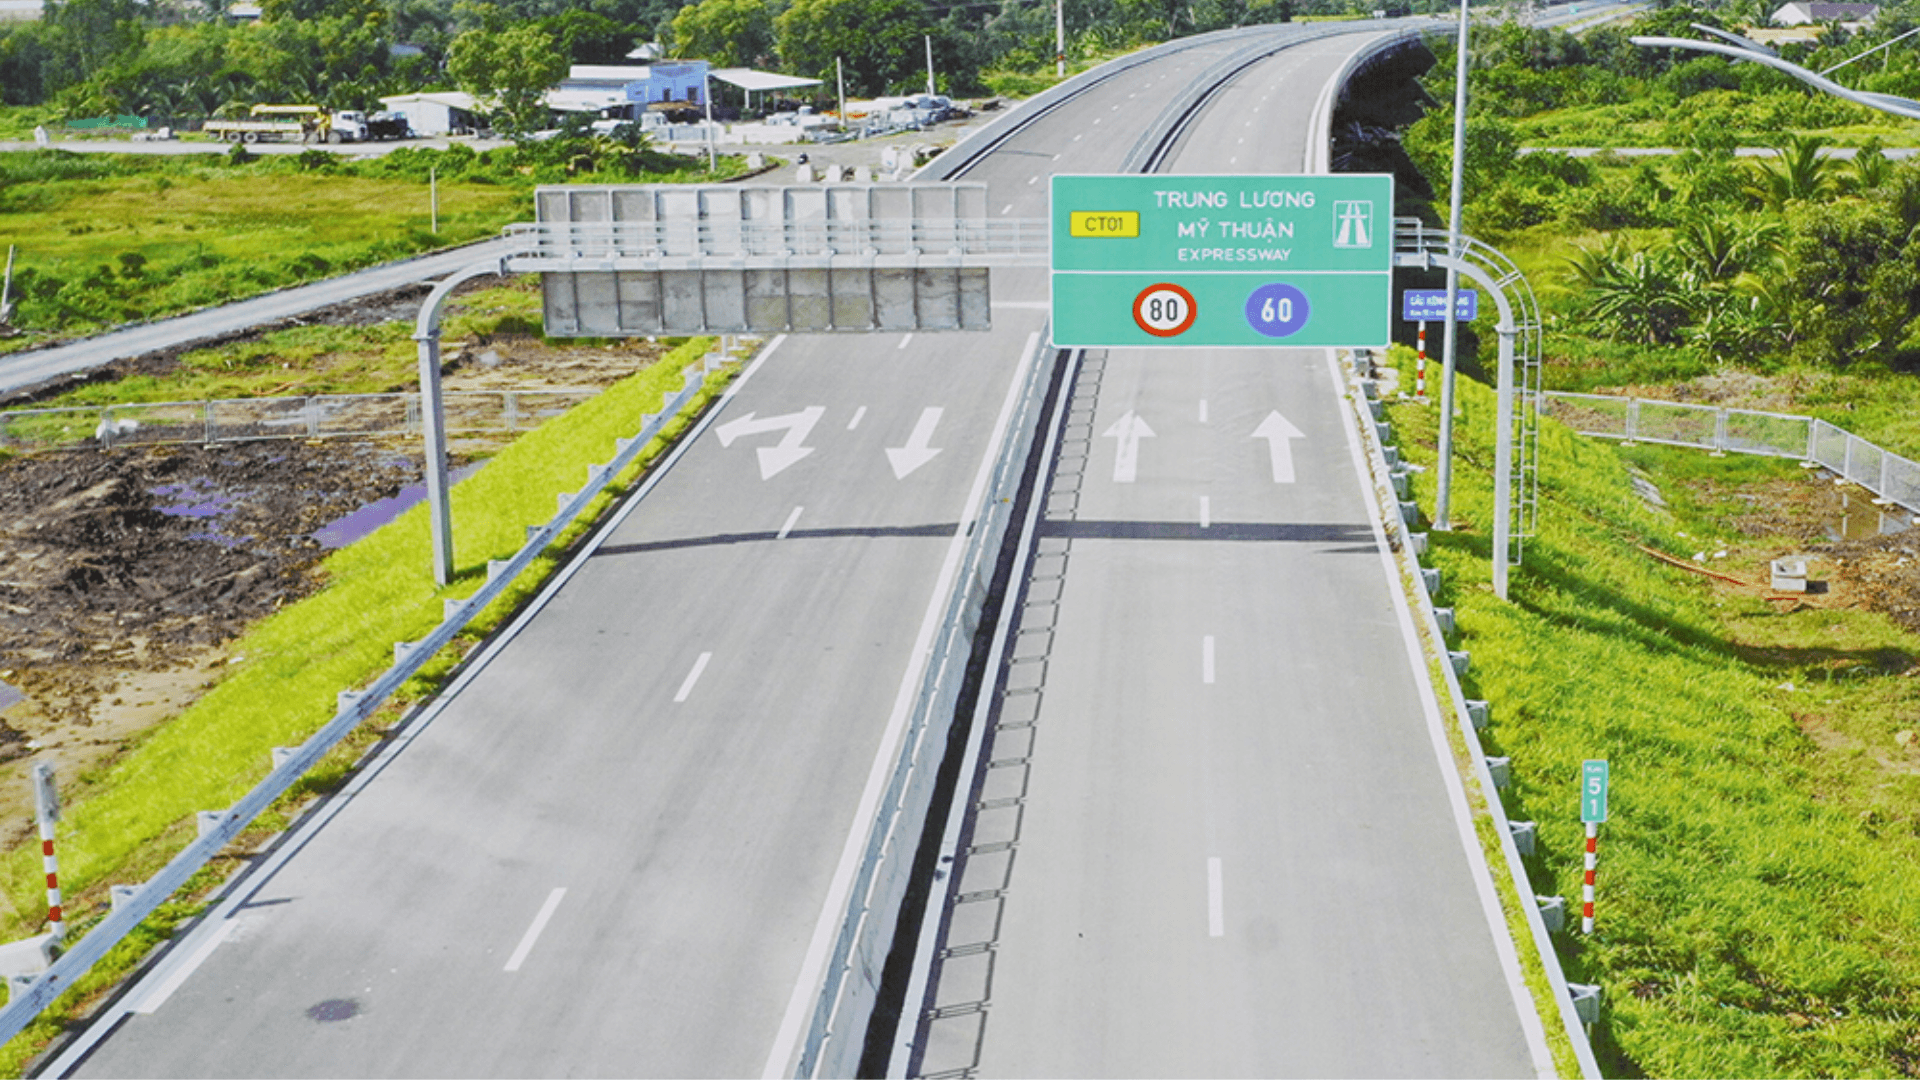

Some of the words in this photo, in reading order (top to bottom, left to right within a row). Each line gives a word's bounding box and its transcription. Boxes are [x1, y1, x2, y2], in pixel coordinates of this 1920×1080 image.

[1153, 190, 1228, 208] TRUNG
[1239, 189, 1316, 209] LƯƠNG
[1085, 217, 1123, 232] CT01
[1178, 217, 1210, 238] MỸ
[1218, 217, 1294, 243] THUẬN
[1177, 247, 1292, 261] EXPRESSWAY
[1150, 299, 1178, 322] 80
[1261, 297, 1292, 322] 60
